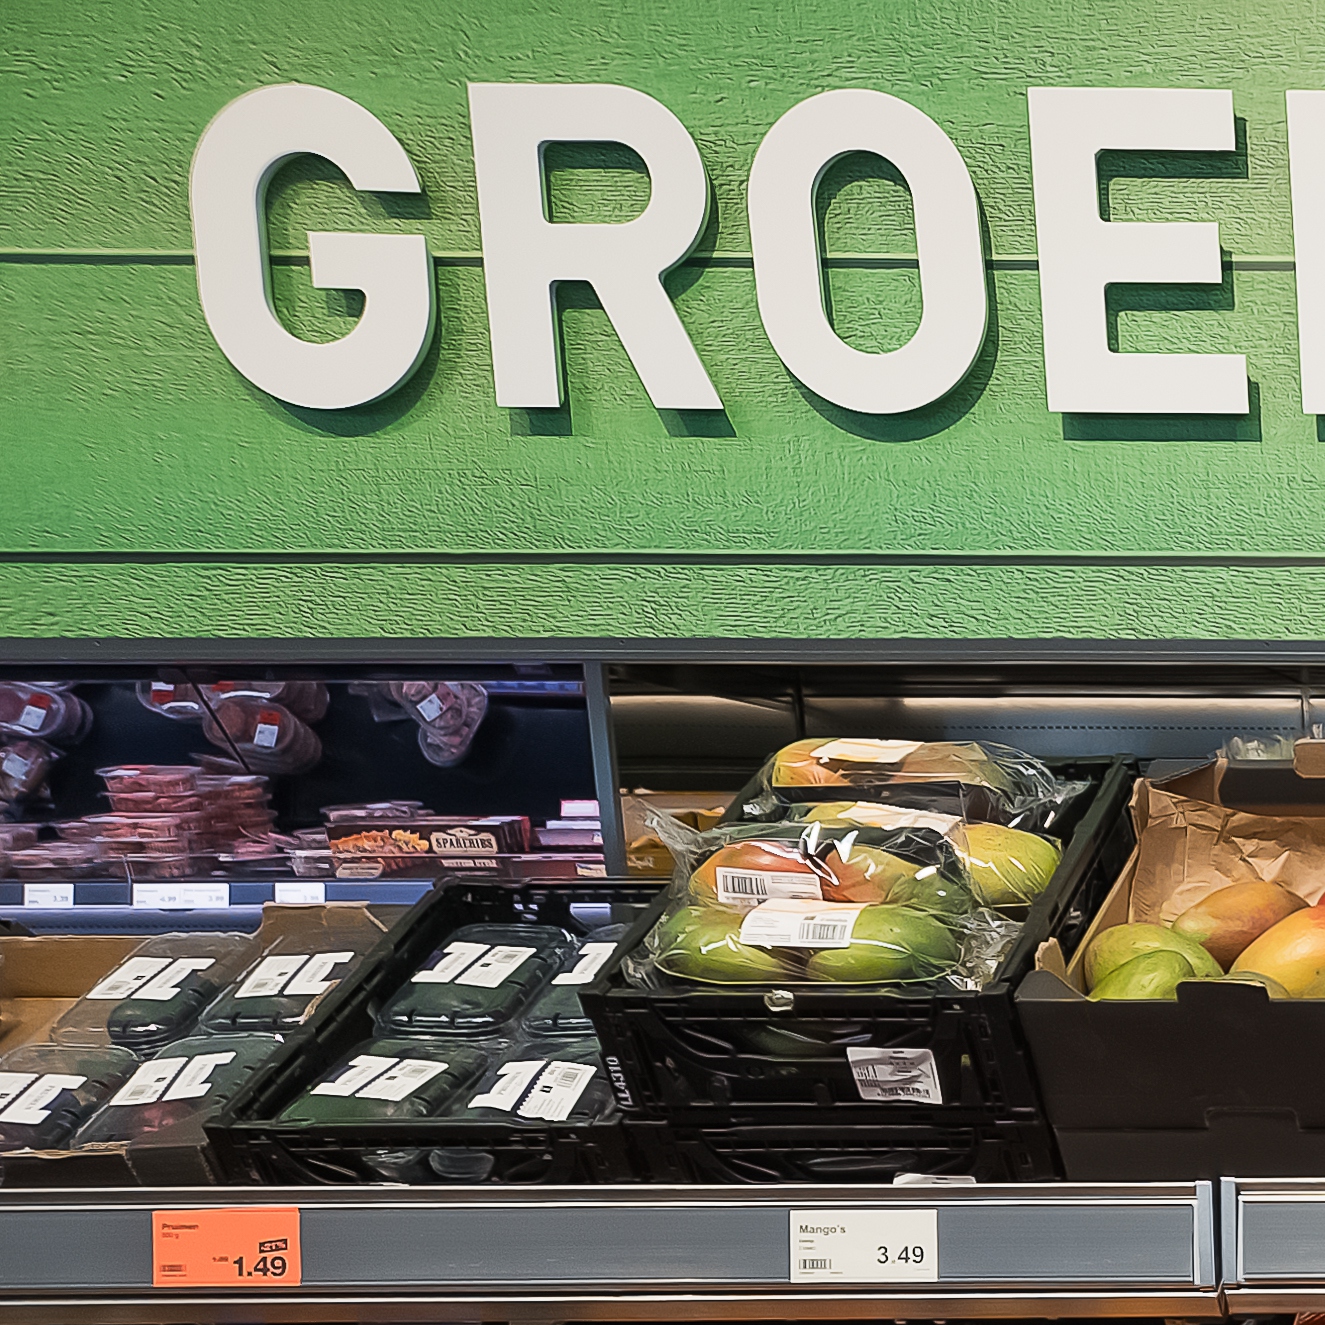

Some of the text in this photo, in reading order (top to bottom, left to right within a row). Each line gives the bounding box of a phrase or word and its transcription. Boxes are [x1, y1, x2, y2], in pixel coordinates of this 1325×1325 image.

[799, 1224, 846, 1236] Mango's
[877, 1245, 925, 1264] 3.49
[233, 1255, 287, 1277] 1.49
